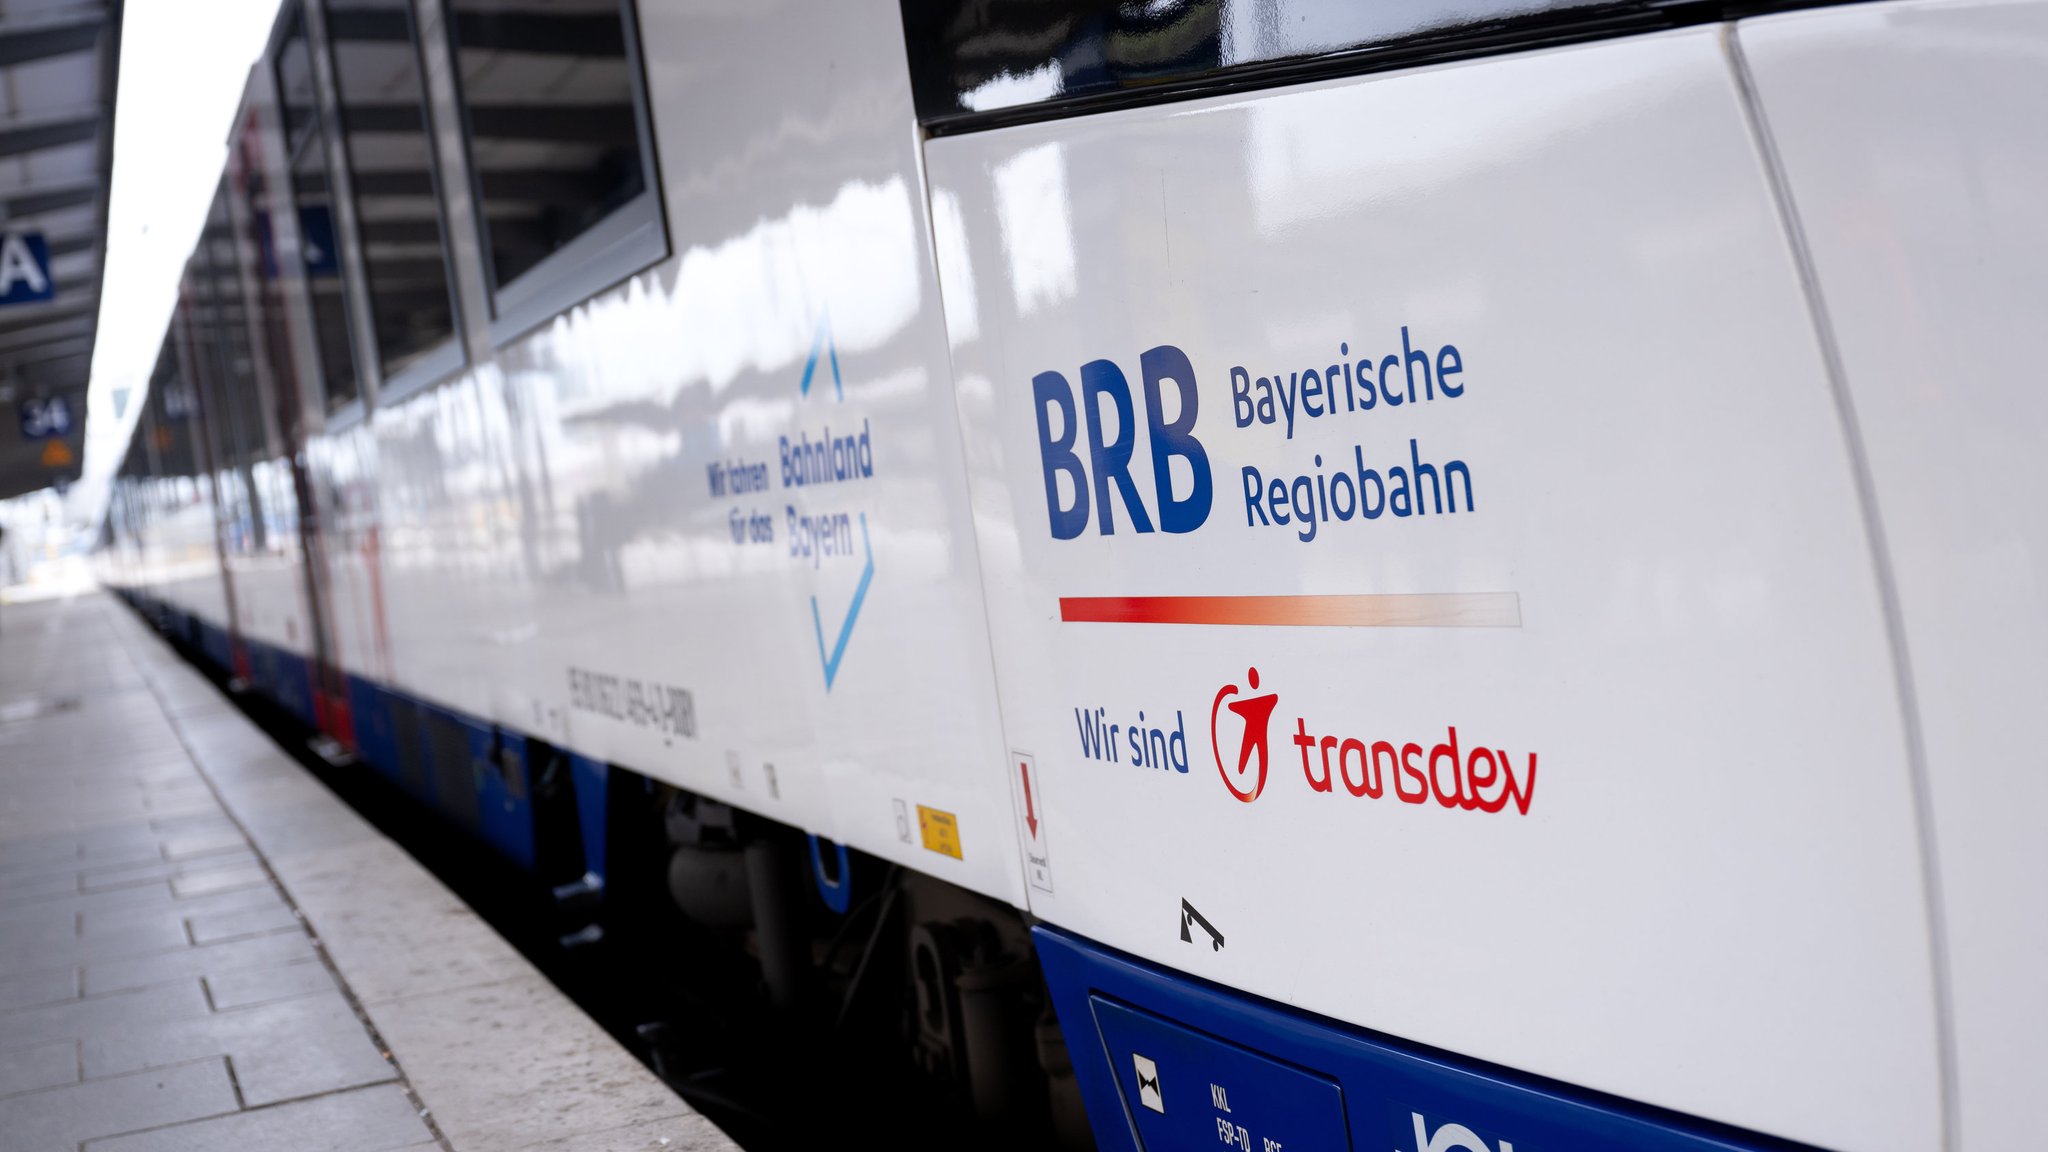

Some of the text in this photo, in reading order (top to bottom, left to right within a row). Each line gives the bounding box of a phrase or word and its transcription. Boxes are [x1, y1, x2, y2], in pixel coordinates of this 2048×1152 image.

[0, 235, 47, 297] A
[1230, 326, 1464, 439] Bayerische
[21, 396, 69, 437] 34
[1032, 345, 1213, 540] BRB
[779, 417, 873, 488] Bahnland
[1241, 439, 1474, 542] Regiobahn
[749, 510, 773, 543] das
[786, 504, 852, 570] Bayern
[1075, 707, 1537, 816] Wir sind transdev
[1210, 1083, 1231, 1113] KKL
[1216, 1117, 1250, 1152] FSP-TD
